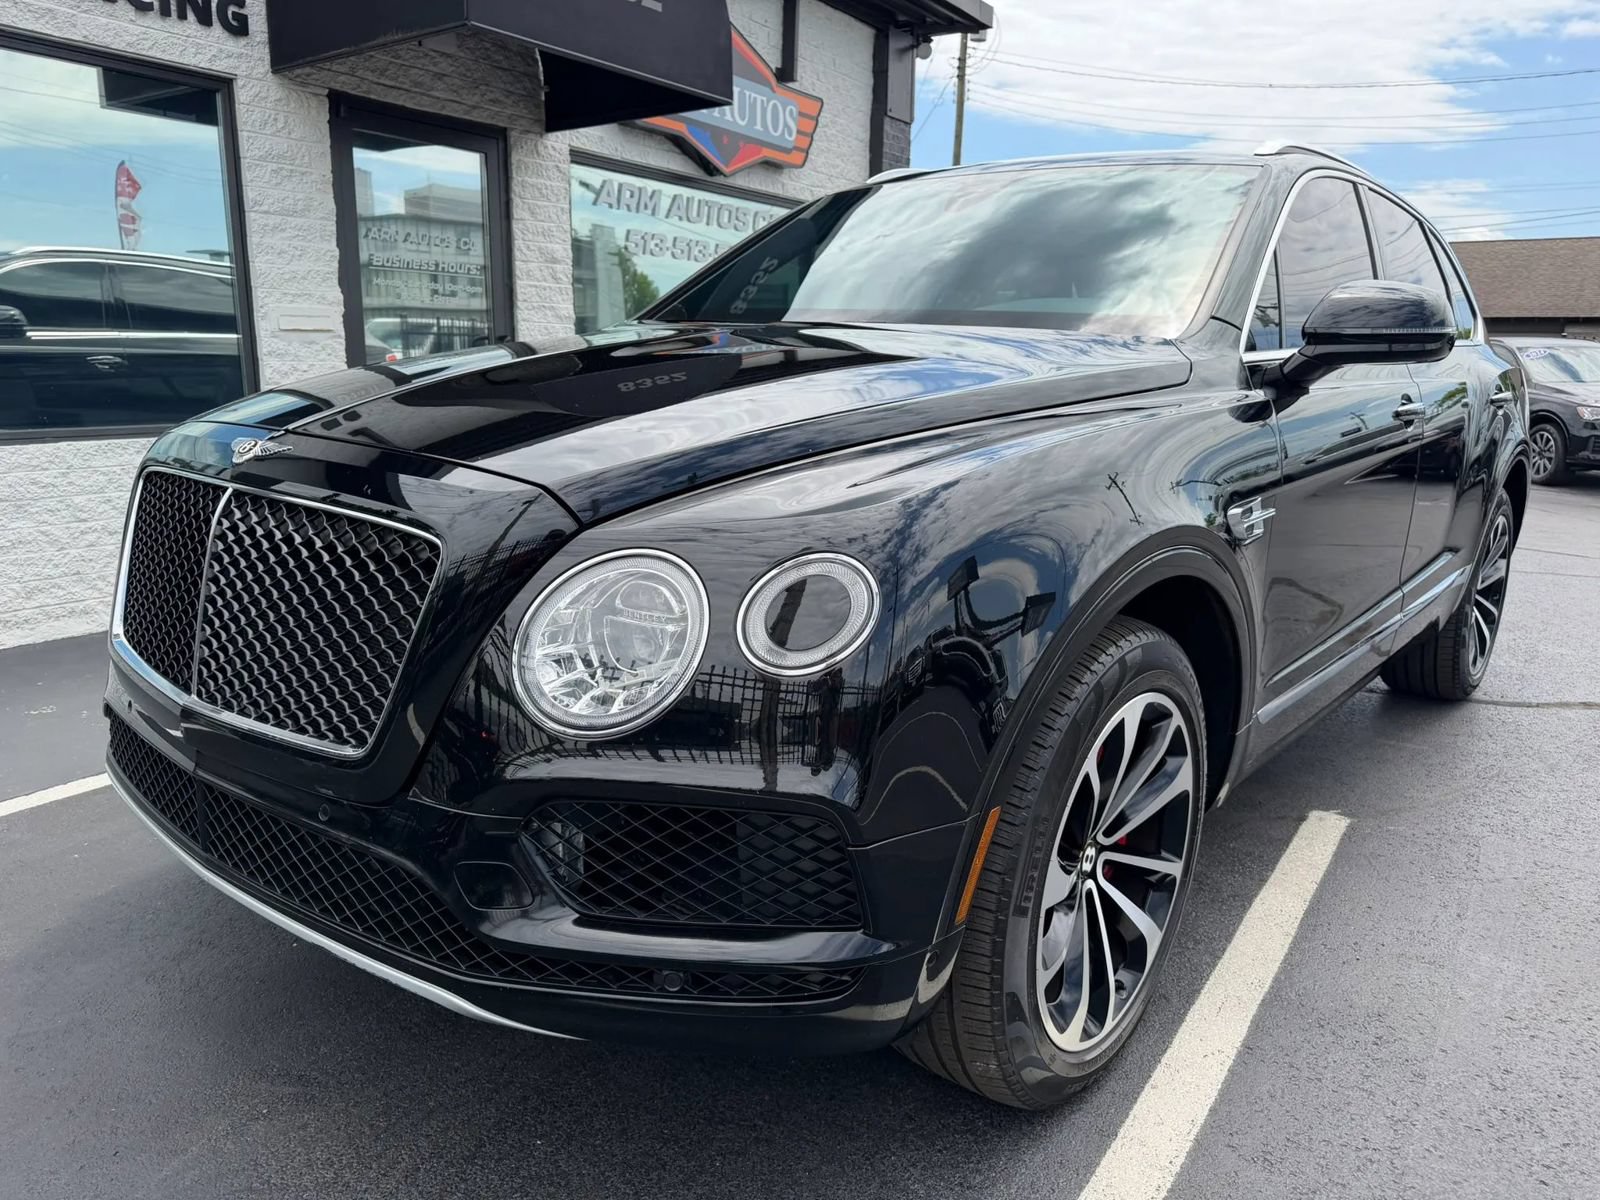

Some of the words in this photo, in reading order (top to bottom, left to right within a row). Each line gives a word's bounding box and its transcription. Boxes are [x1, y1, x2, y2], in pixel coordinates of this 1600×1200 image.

[592, 179, 662, 217] ARM
[665, 194, 749, 232] AUTOS
[369, 253, 436, 270] Business
[439, 261, 480, 275] Hours:
